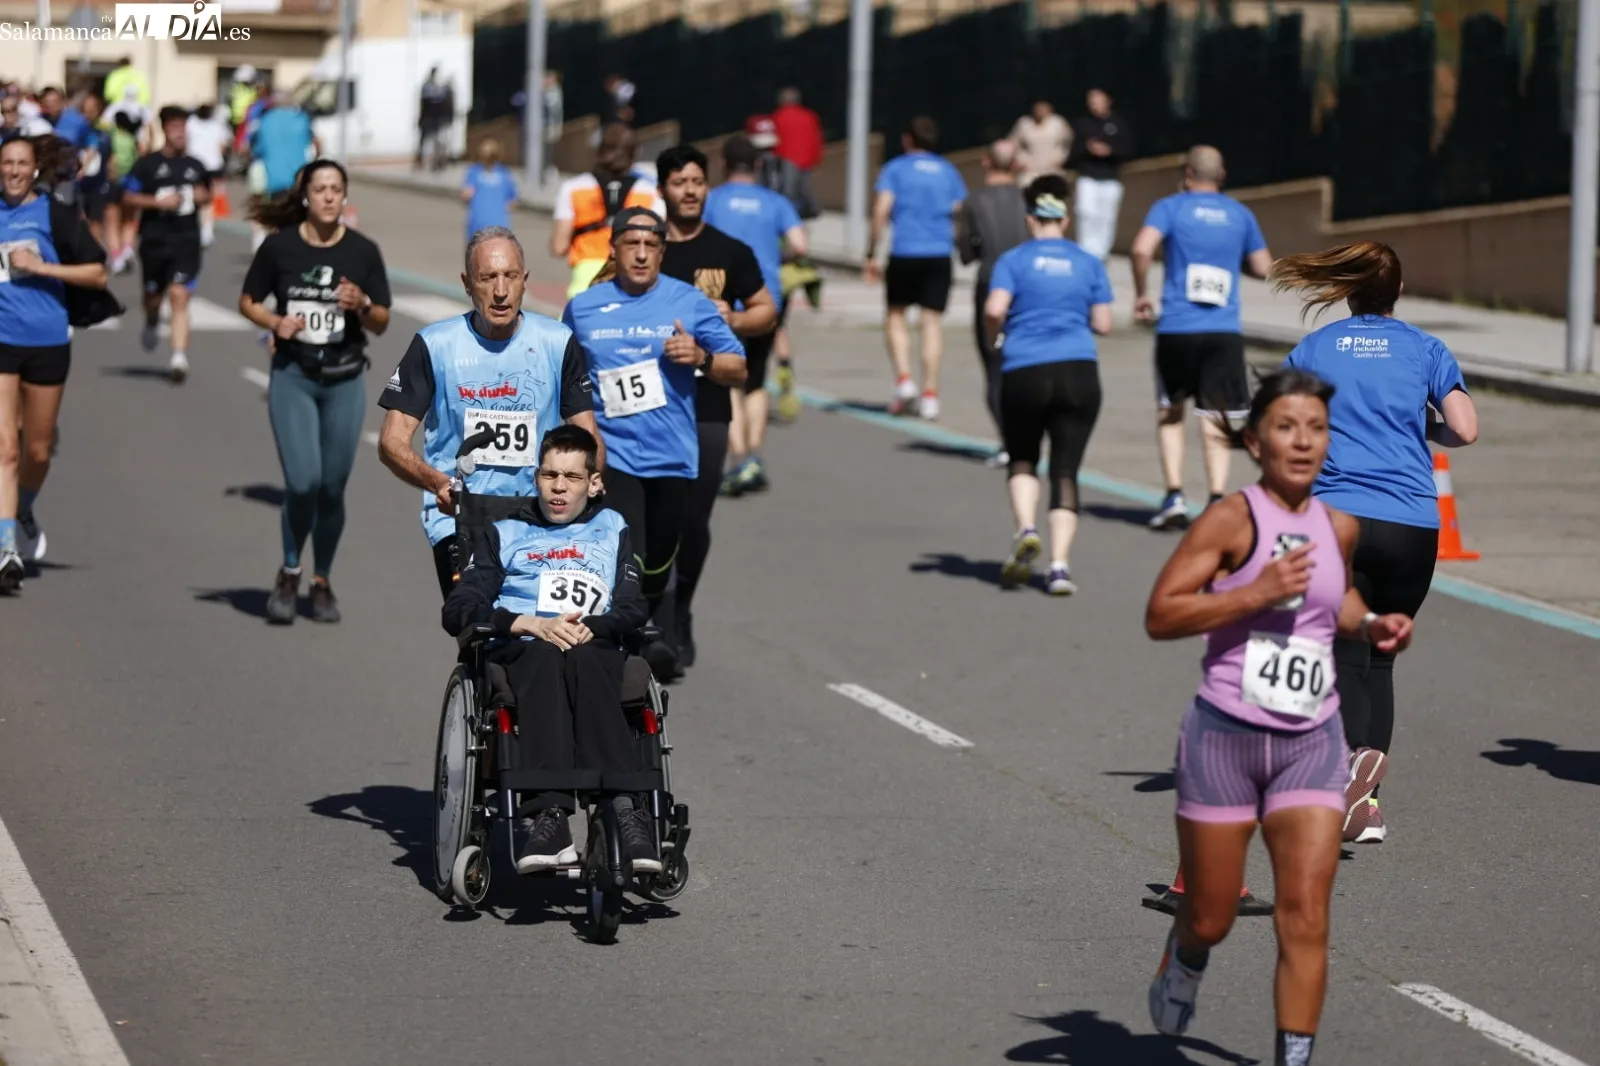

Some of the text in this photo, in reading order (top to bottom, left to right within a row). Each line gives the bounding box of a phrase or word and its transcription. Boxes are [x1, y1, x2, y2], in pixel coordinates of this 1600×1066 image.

[1354, 336, 1388, 345] Plena
[615, 374, 646, 401] 15
[550, 576, 603, 615] 357
[1259, 652, 1323, 696] 460
